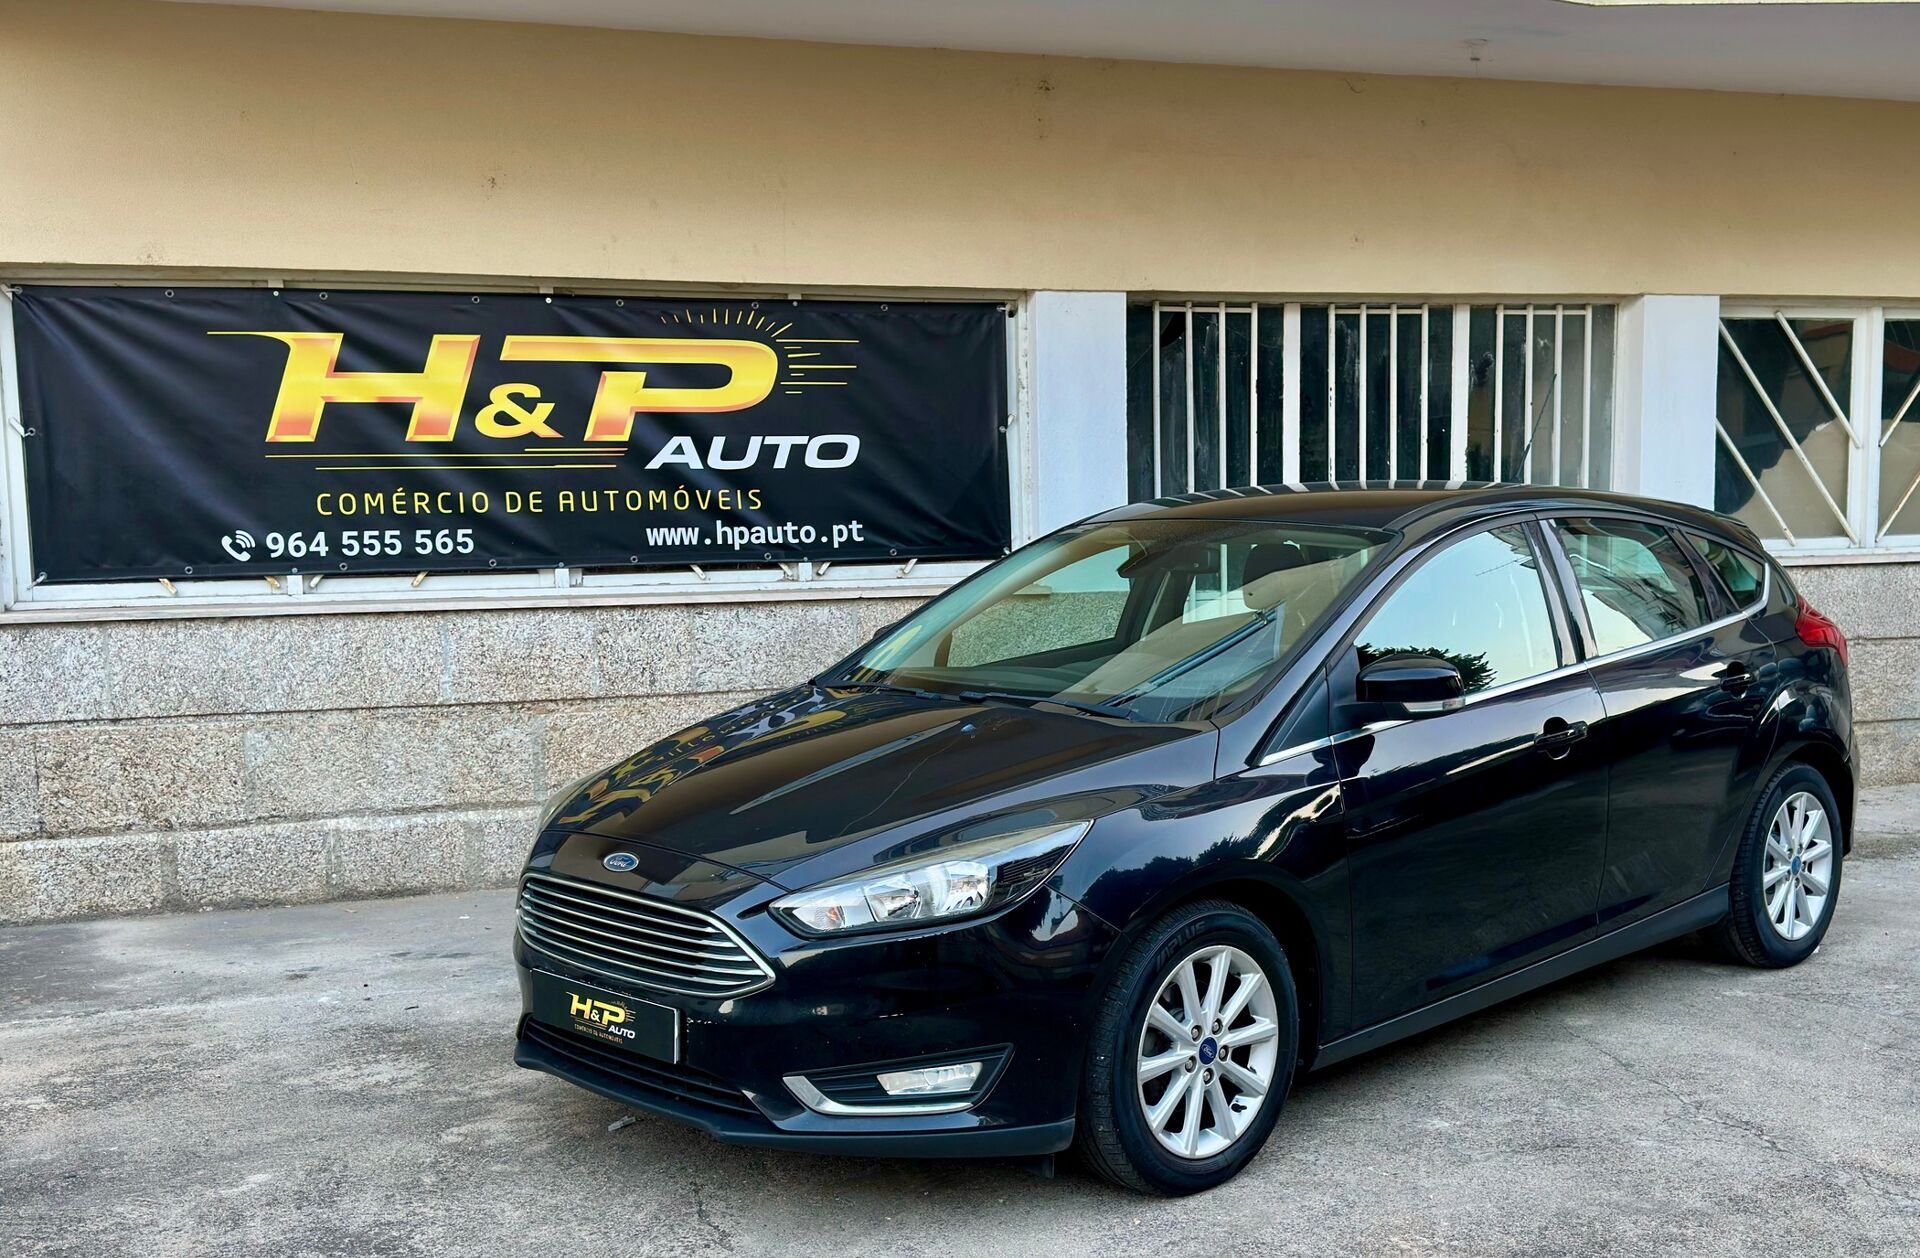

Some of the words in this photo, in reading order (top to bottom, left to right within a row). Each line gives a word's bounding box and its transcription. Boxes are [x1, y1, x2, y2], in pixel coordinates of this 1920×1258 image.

[207, 331, 779, 443] H&P
[644, 434, 862, 470] AUTO
[316, 487, 490, 516] COMÉRCIO
[505, 491, 544, 513] DE
[558, 485, 762, 512] AUTOMÓVEIS
[265, 531, 329, 559] 964
[341, 530, 402, 556] 555
[415, 528, 475, 555] 565
[646, 520, 865, 550] www.hpauto.pt
[567, 992, 626, 1026] H&P
[608, 1024, 636, 1039] AUTO
